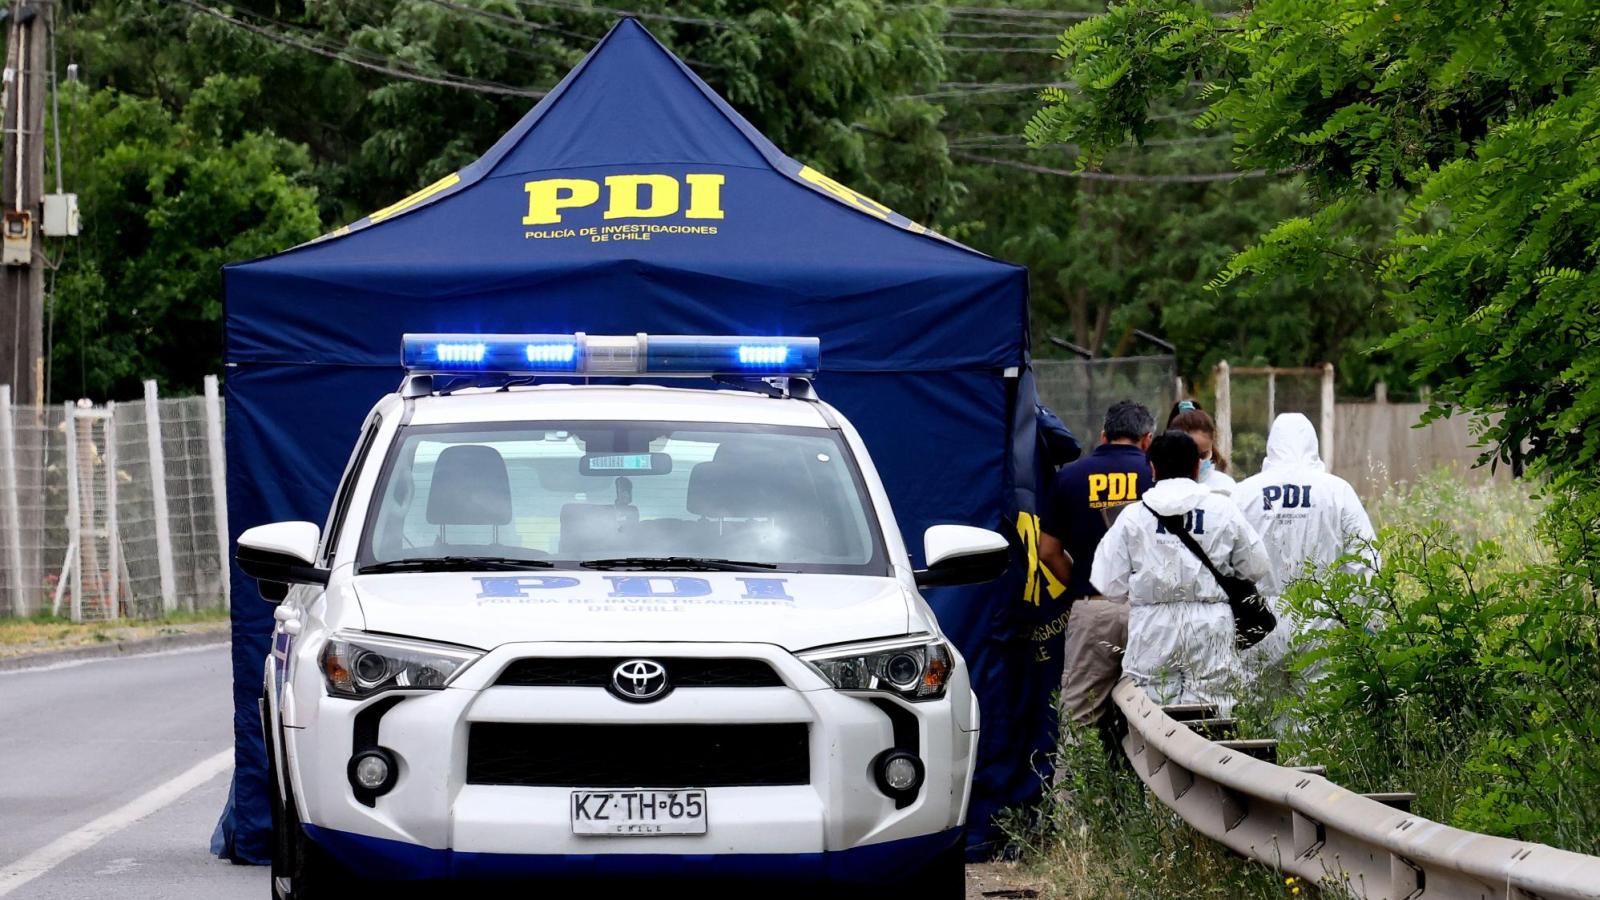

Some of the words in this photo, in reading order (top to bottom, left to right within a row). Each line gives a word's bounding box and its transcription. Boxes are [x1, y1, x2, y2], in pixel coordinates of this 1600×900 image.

[522, 173, 725, 225] PDI
[525, 228, 576, 239] POLICÍA
[579, 227, 598, 236] DE
[601, 224, 718, 235] INVESTIGACIONES
[591, 233, 609, 243] DE
[613, 233, 651, 241] CHILE
[1088, 472, 1138, 502] PDI
[1262, 484, 1312, 511] PDI
[472, 576, 794, 601] PDI
